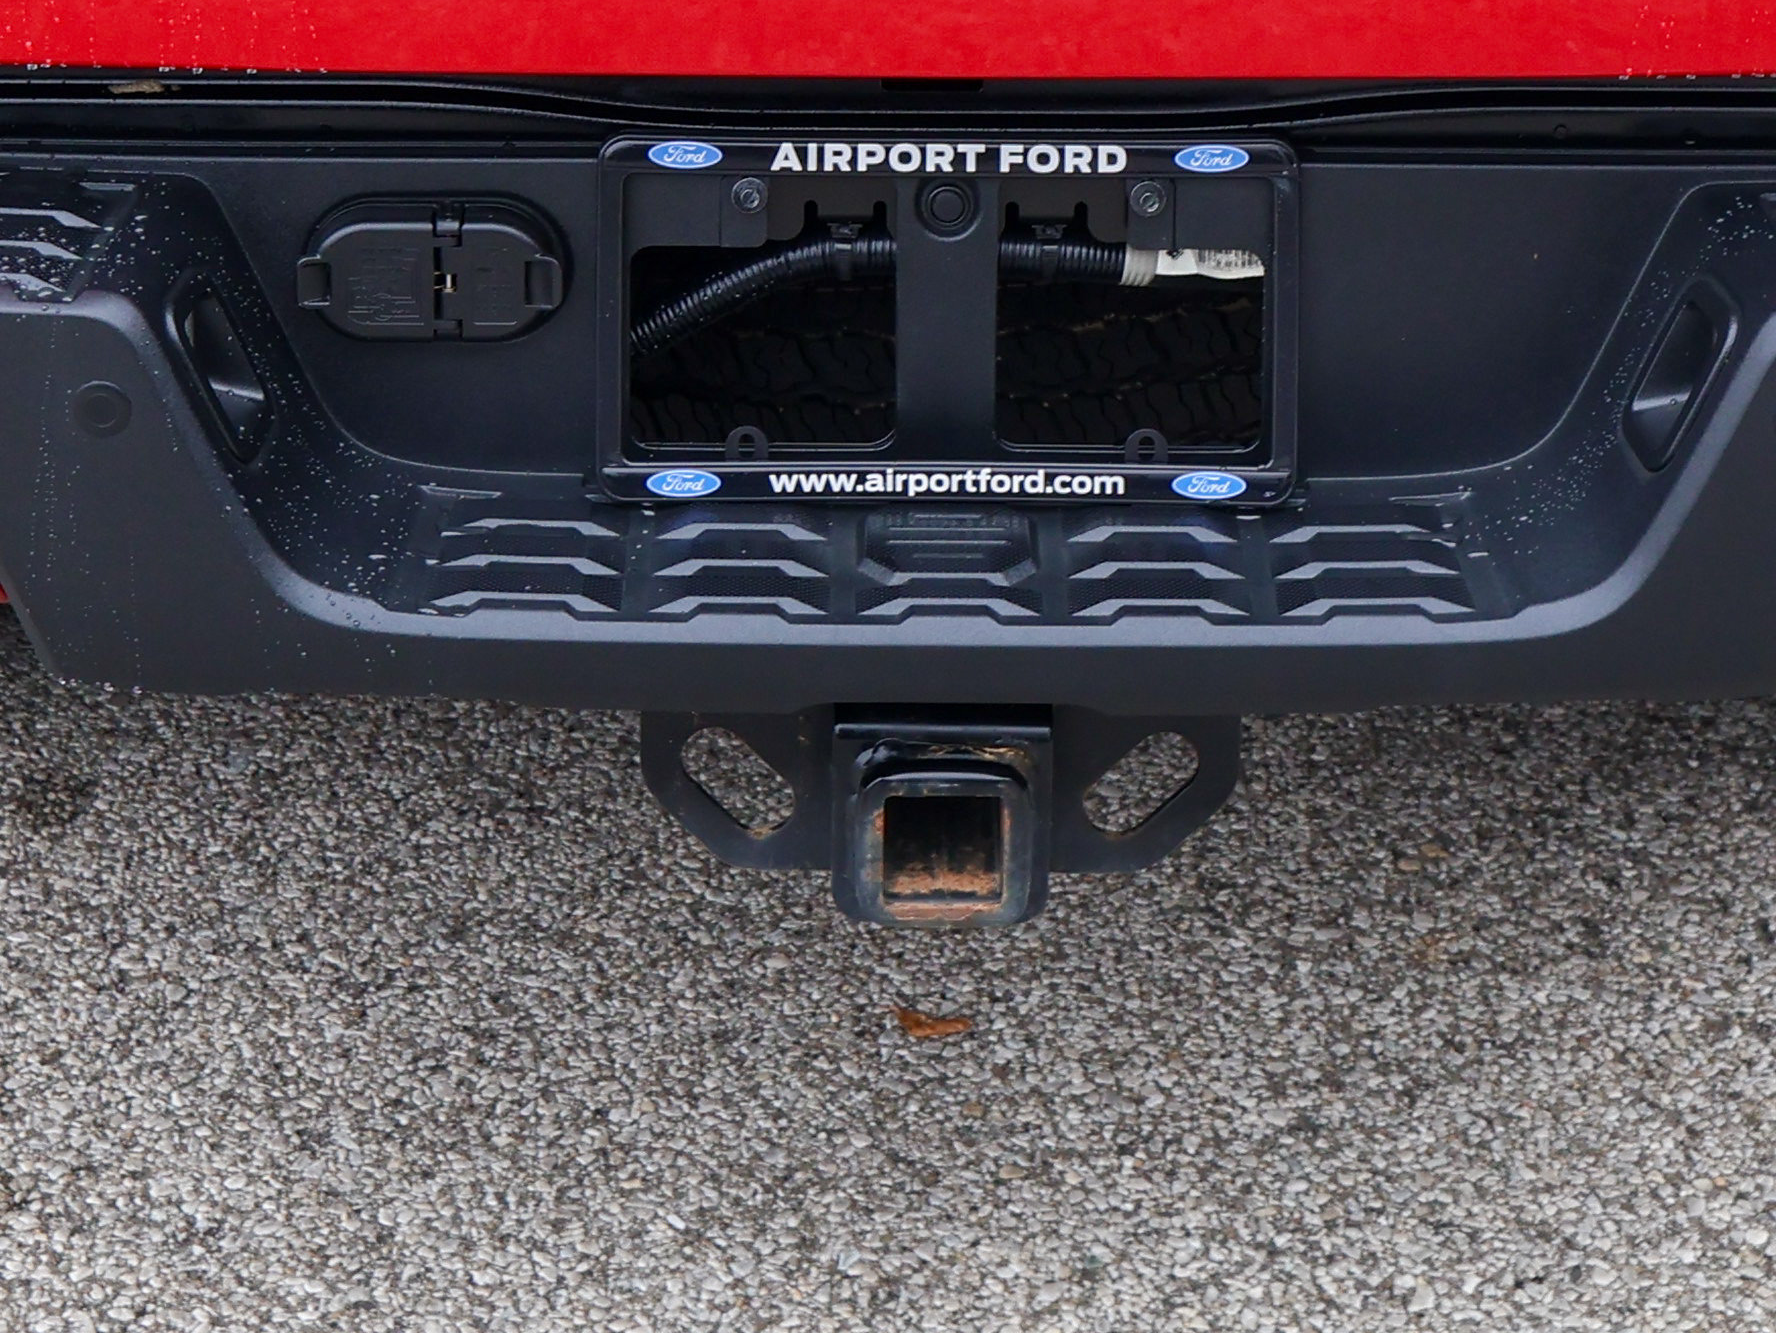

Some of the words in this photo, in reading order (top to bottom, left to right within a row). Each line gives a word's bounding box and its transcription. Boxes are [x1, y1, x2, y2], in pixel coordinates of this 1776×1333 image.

[770, 142, 986, 173] AIRPORT
[999, 143, 1128, 174] FORD
[768, 468, 1125, 497] www.airportford.com
